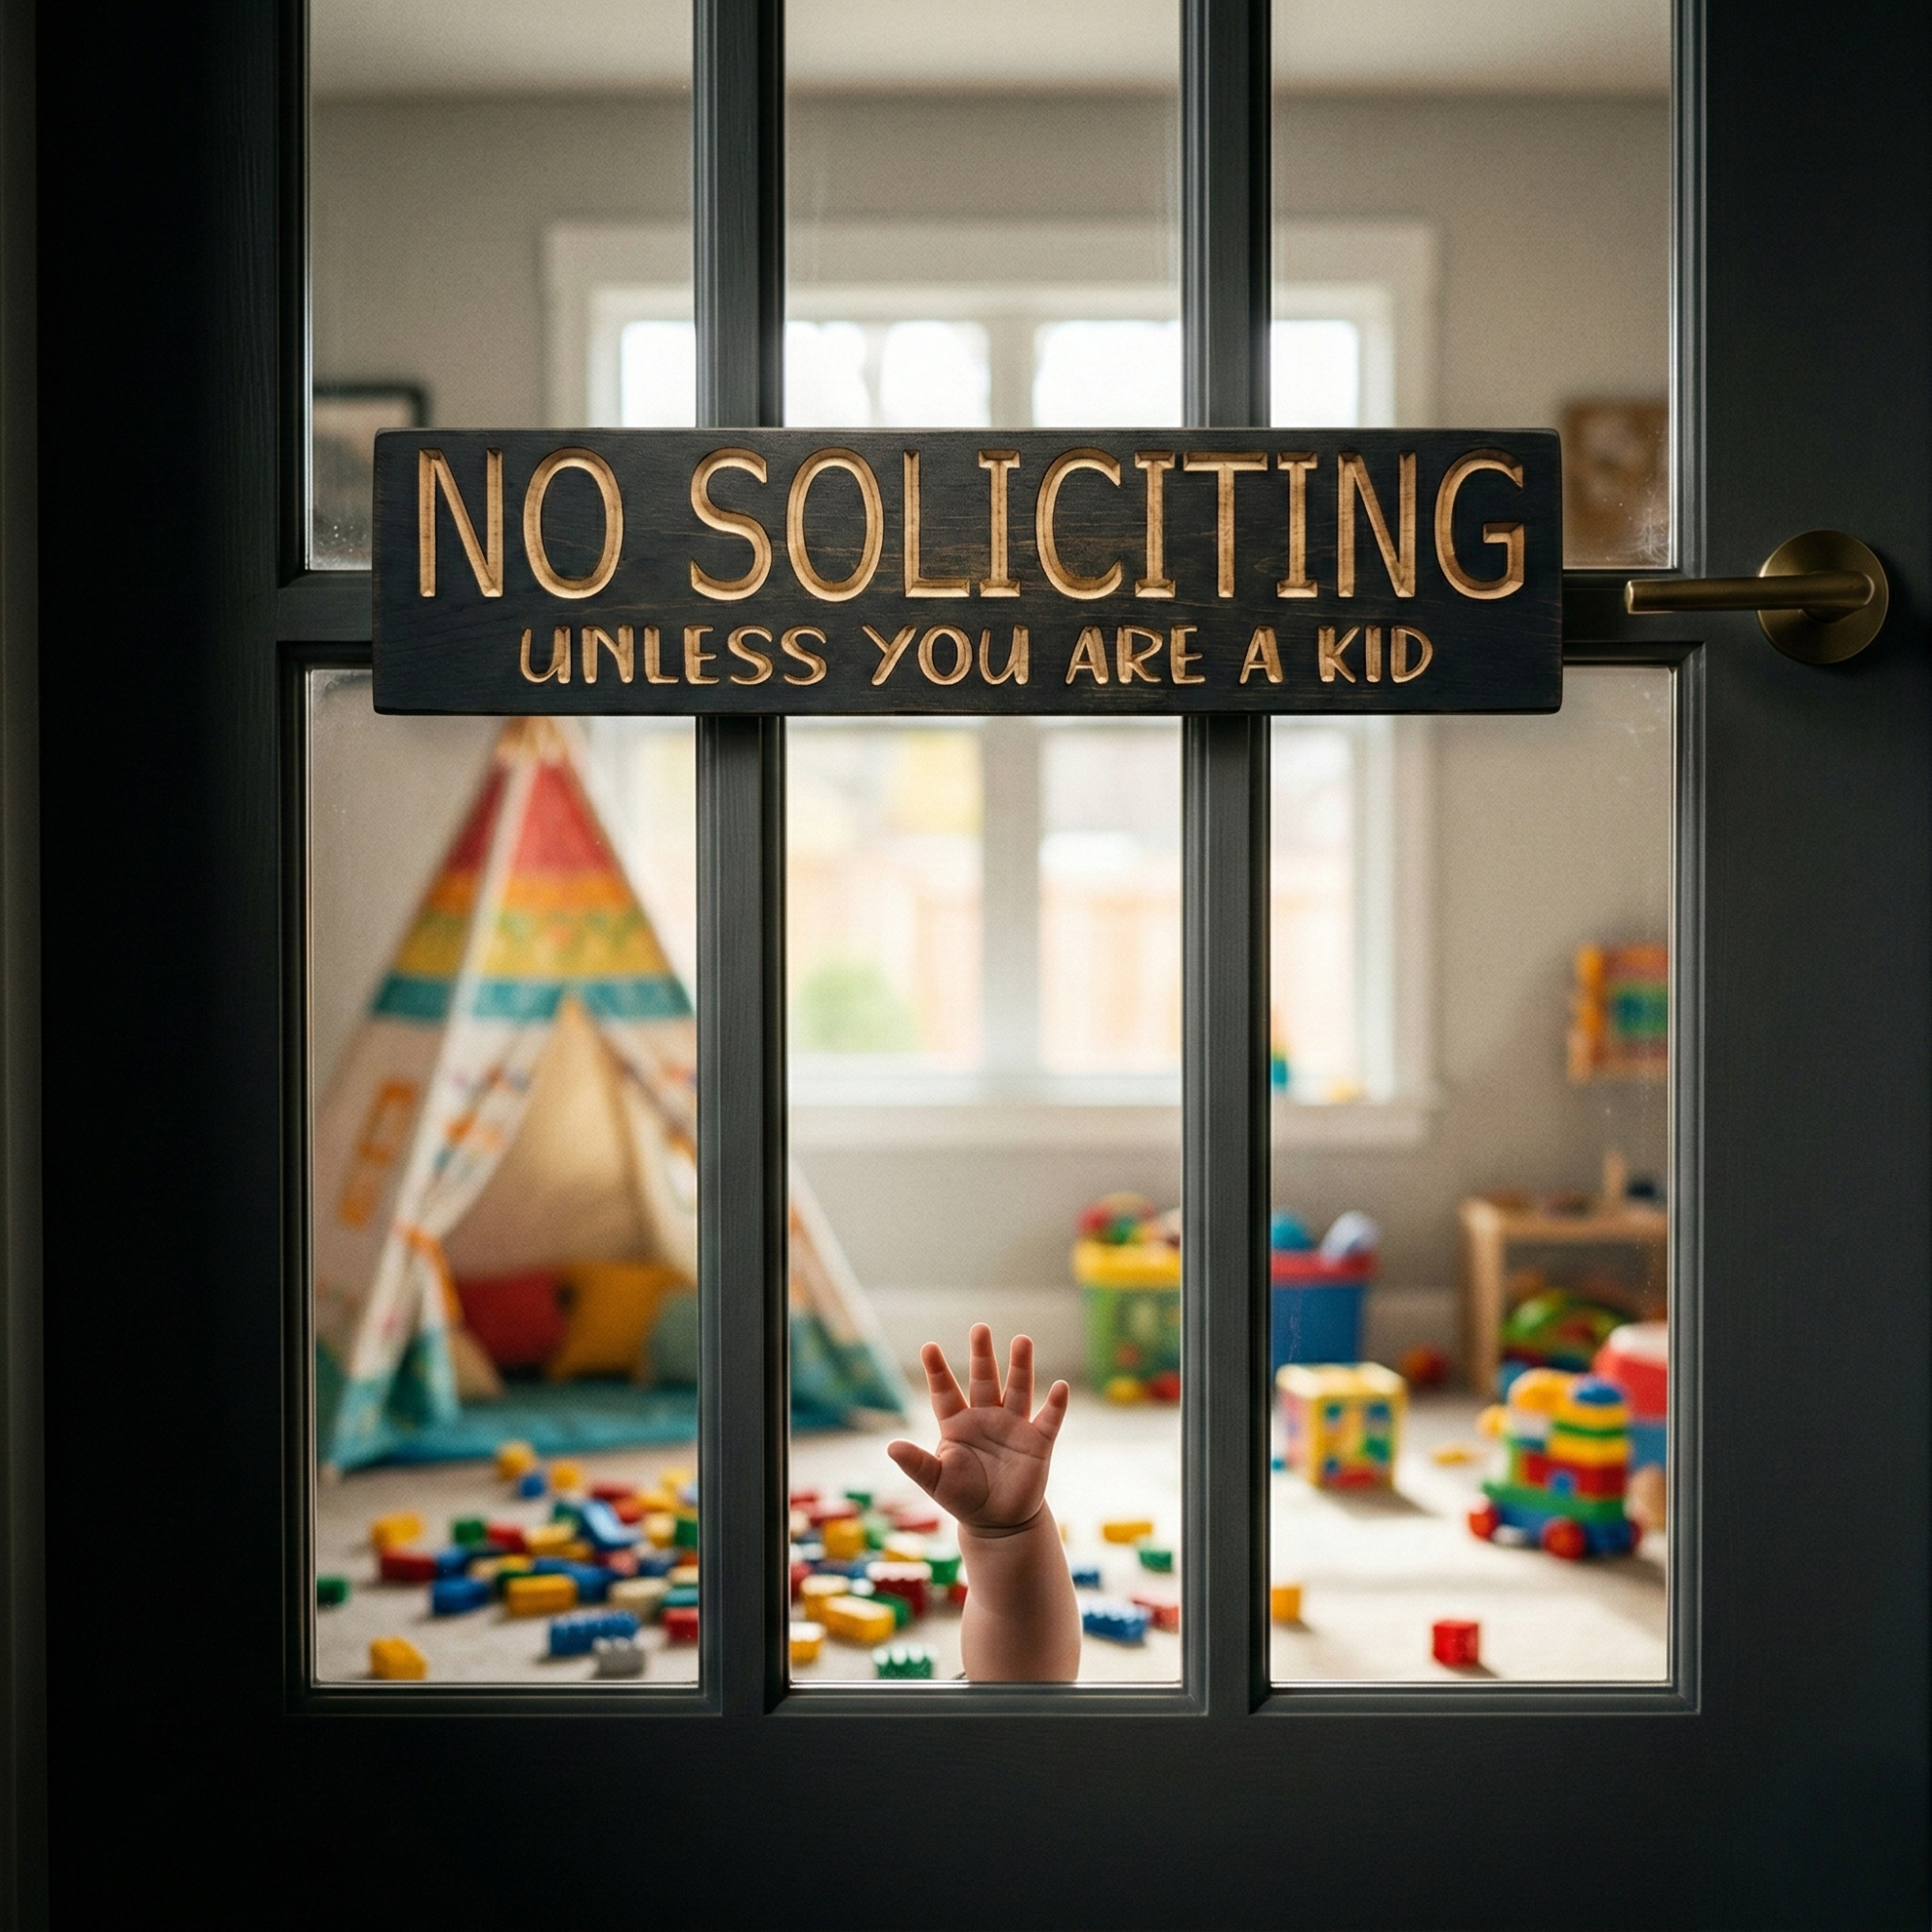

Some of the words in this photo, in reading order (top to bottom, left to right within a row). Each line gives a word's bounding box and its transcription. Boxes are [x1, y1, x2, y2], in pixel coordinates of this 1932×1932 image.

[418, 448, 624, 601] NO
[689, 447, 1526, 602] SOLICITING
[519, 625, 828, 686] UNLESS
[862, 625, 1031, 686] YOU
[1065, 628, 1206, 686] ARE
[1239, 628, 1284, 685] A
[1318, 627, 1435, 684] KID
